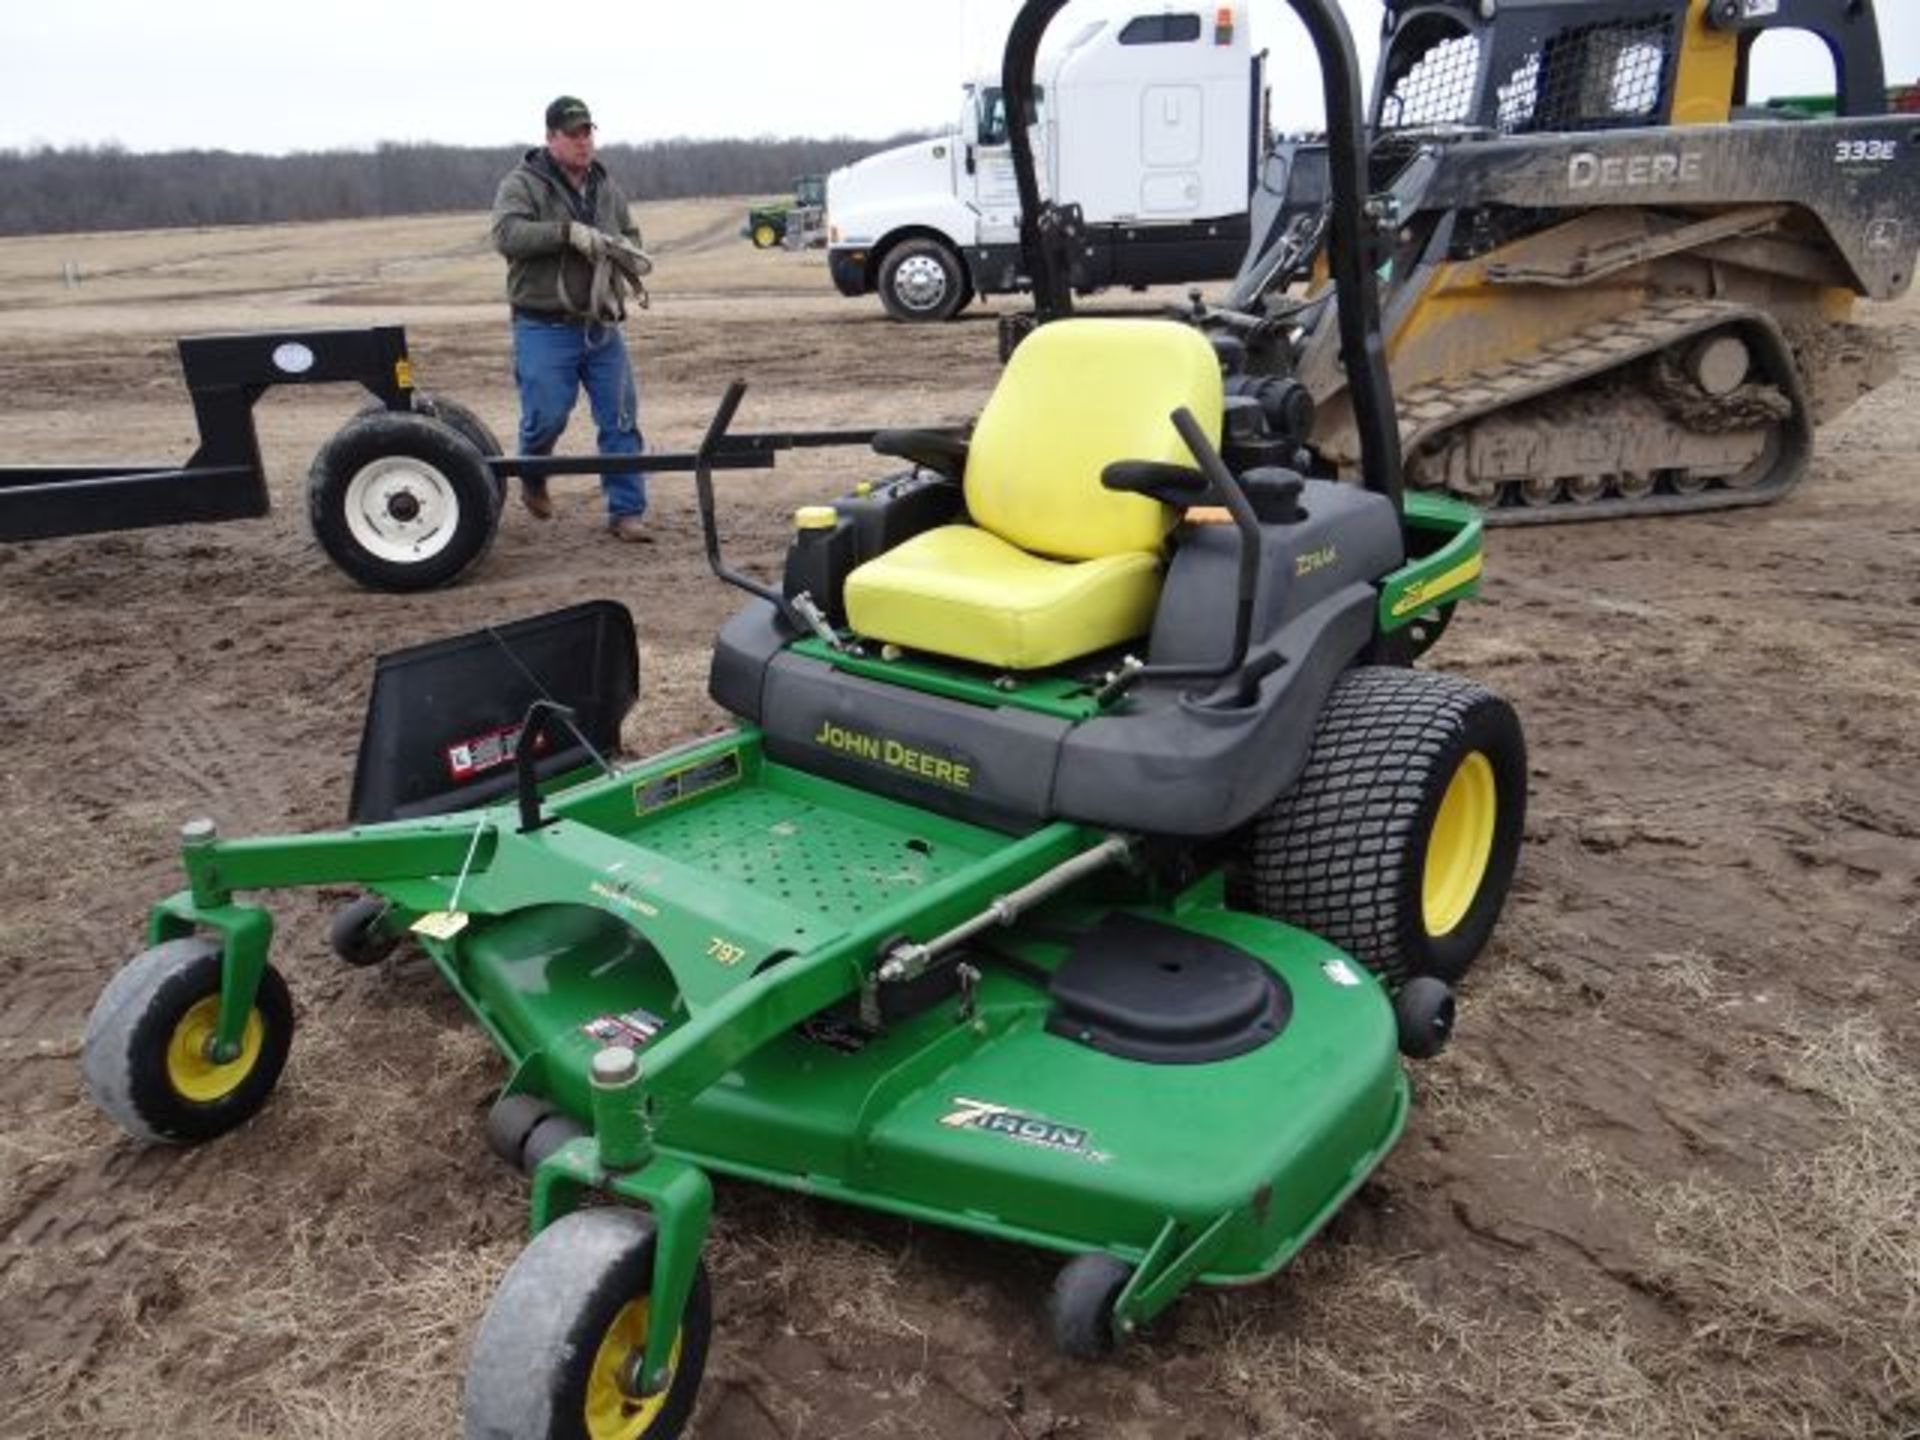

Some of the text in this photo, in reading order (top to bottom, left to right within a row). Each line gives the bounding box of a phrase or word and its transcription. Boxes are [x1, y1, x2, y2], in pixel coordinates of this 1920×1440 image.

[1834, 140, 1897, 162] 333E
[1569, 152, 1702, 188] DEERE
[816, 720, 970, 787] JOHN DEERE
[706, 936, 746, 966] 797
